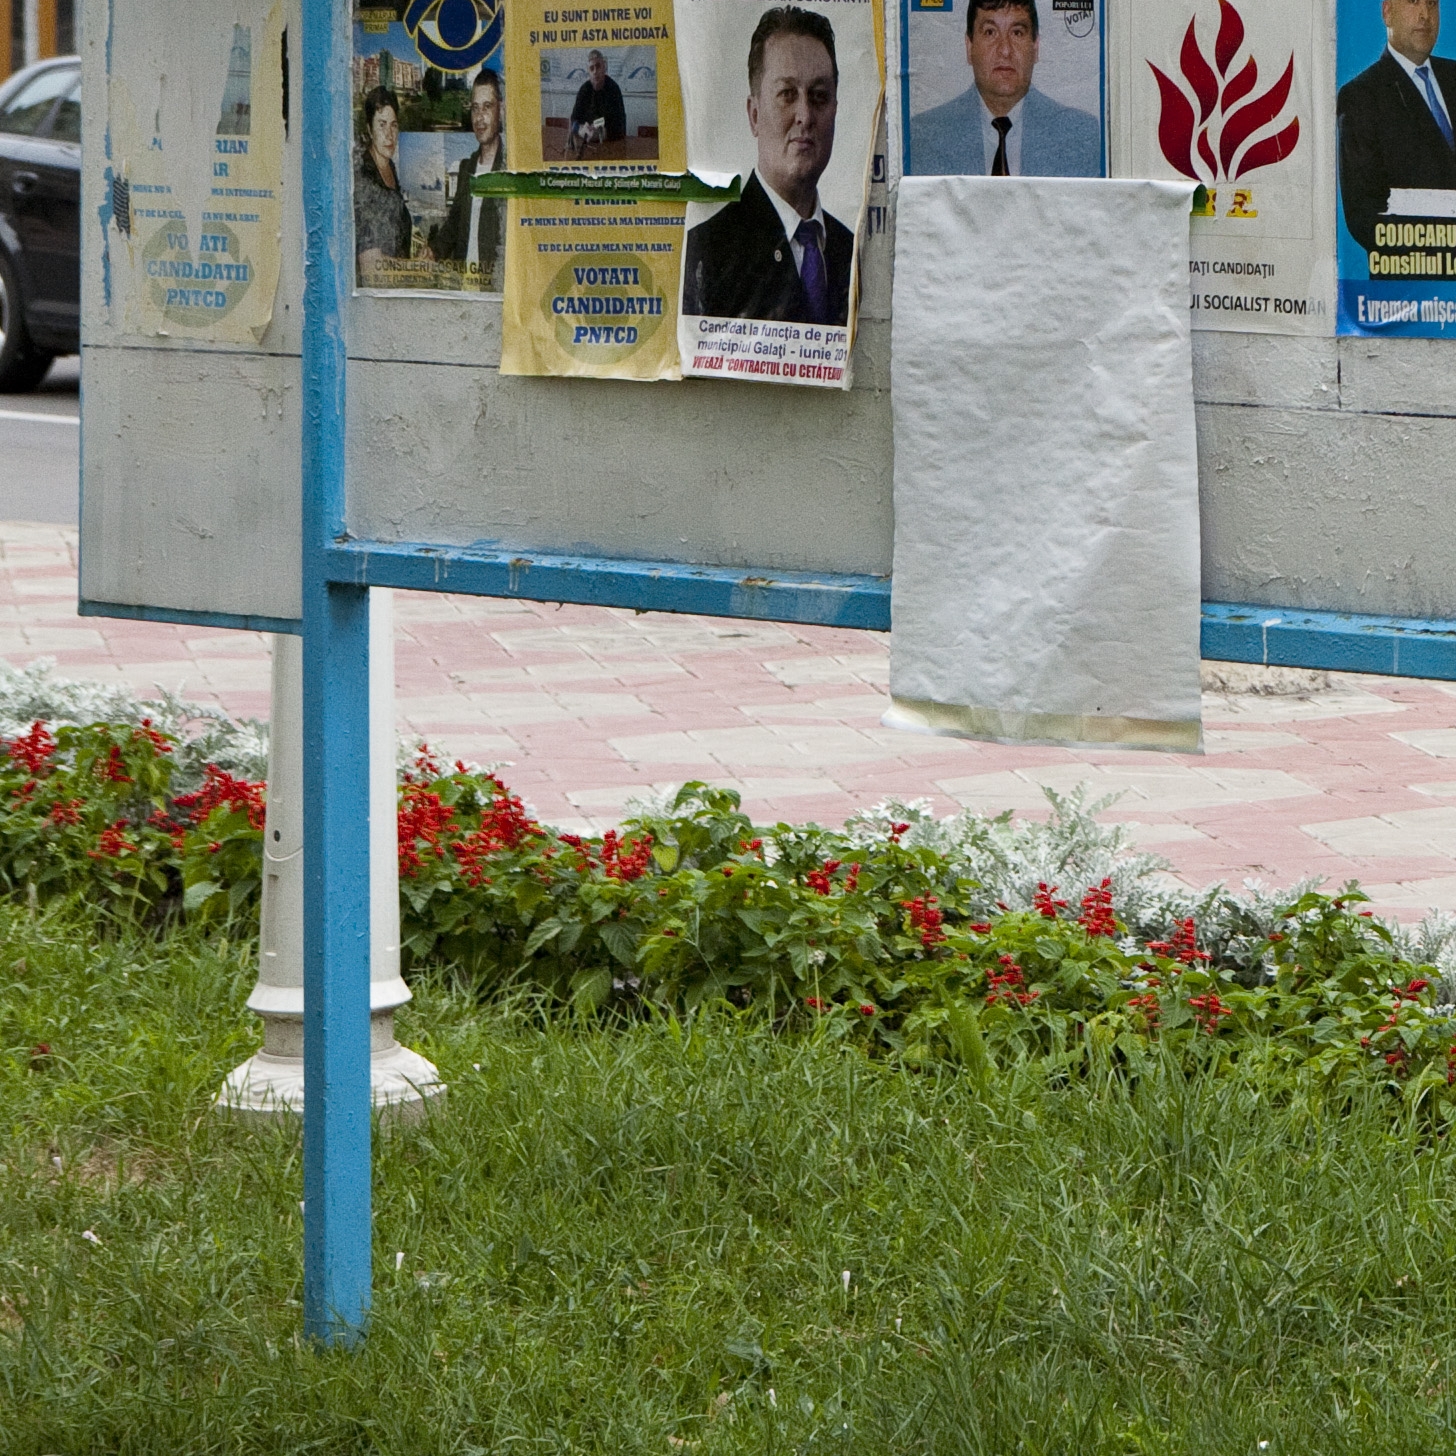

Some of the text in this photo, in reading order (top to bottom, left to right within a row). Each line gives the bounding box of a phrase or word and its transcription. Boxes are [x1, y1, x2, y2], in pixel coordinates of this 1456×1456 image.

[699, 320, 746, 334] Candidat
[750, 324, 758, 335] la
[805, 329, 821, 341] de
